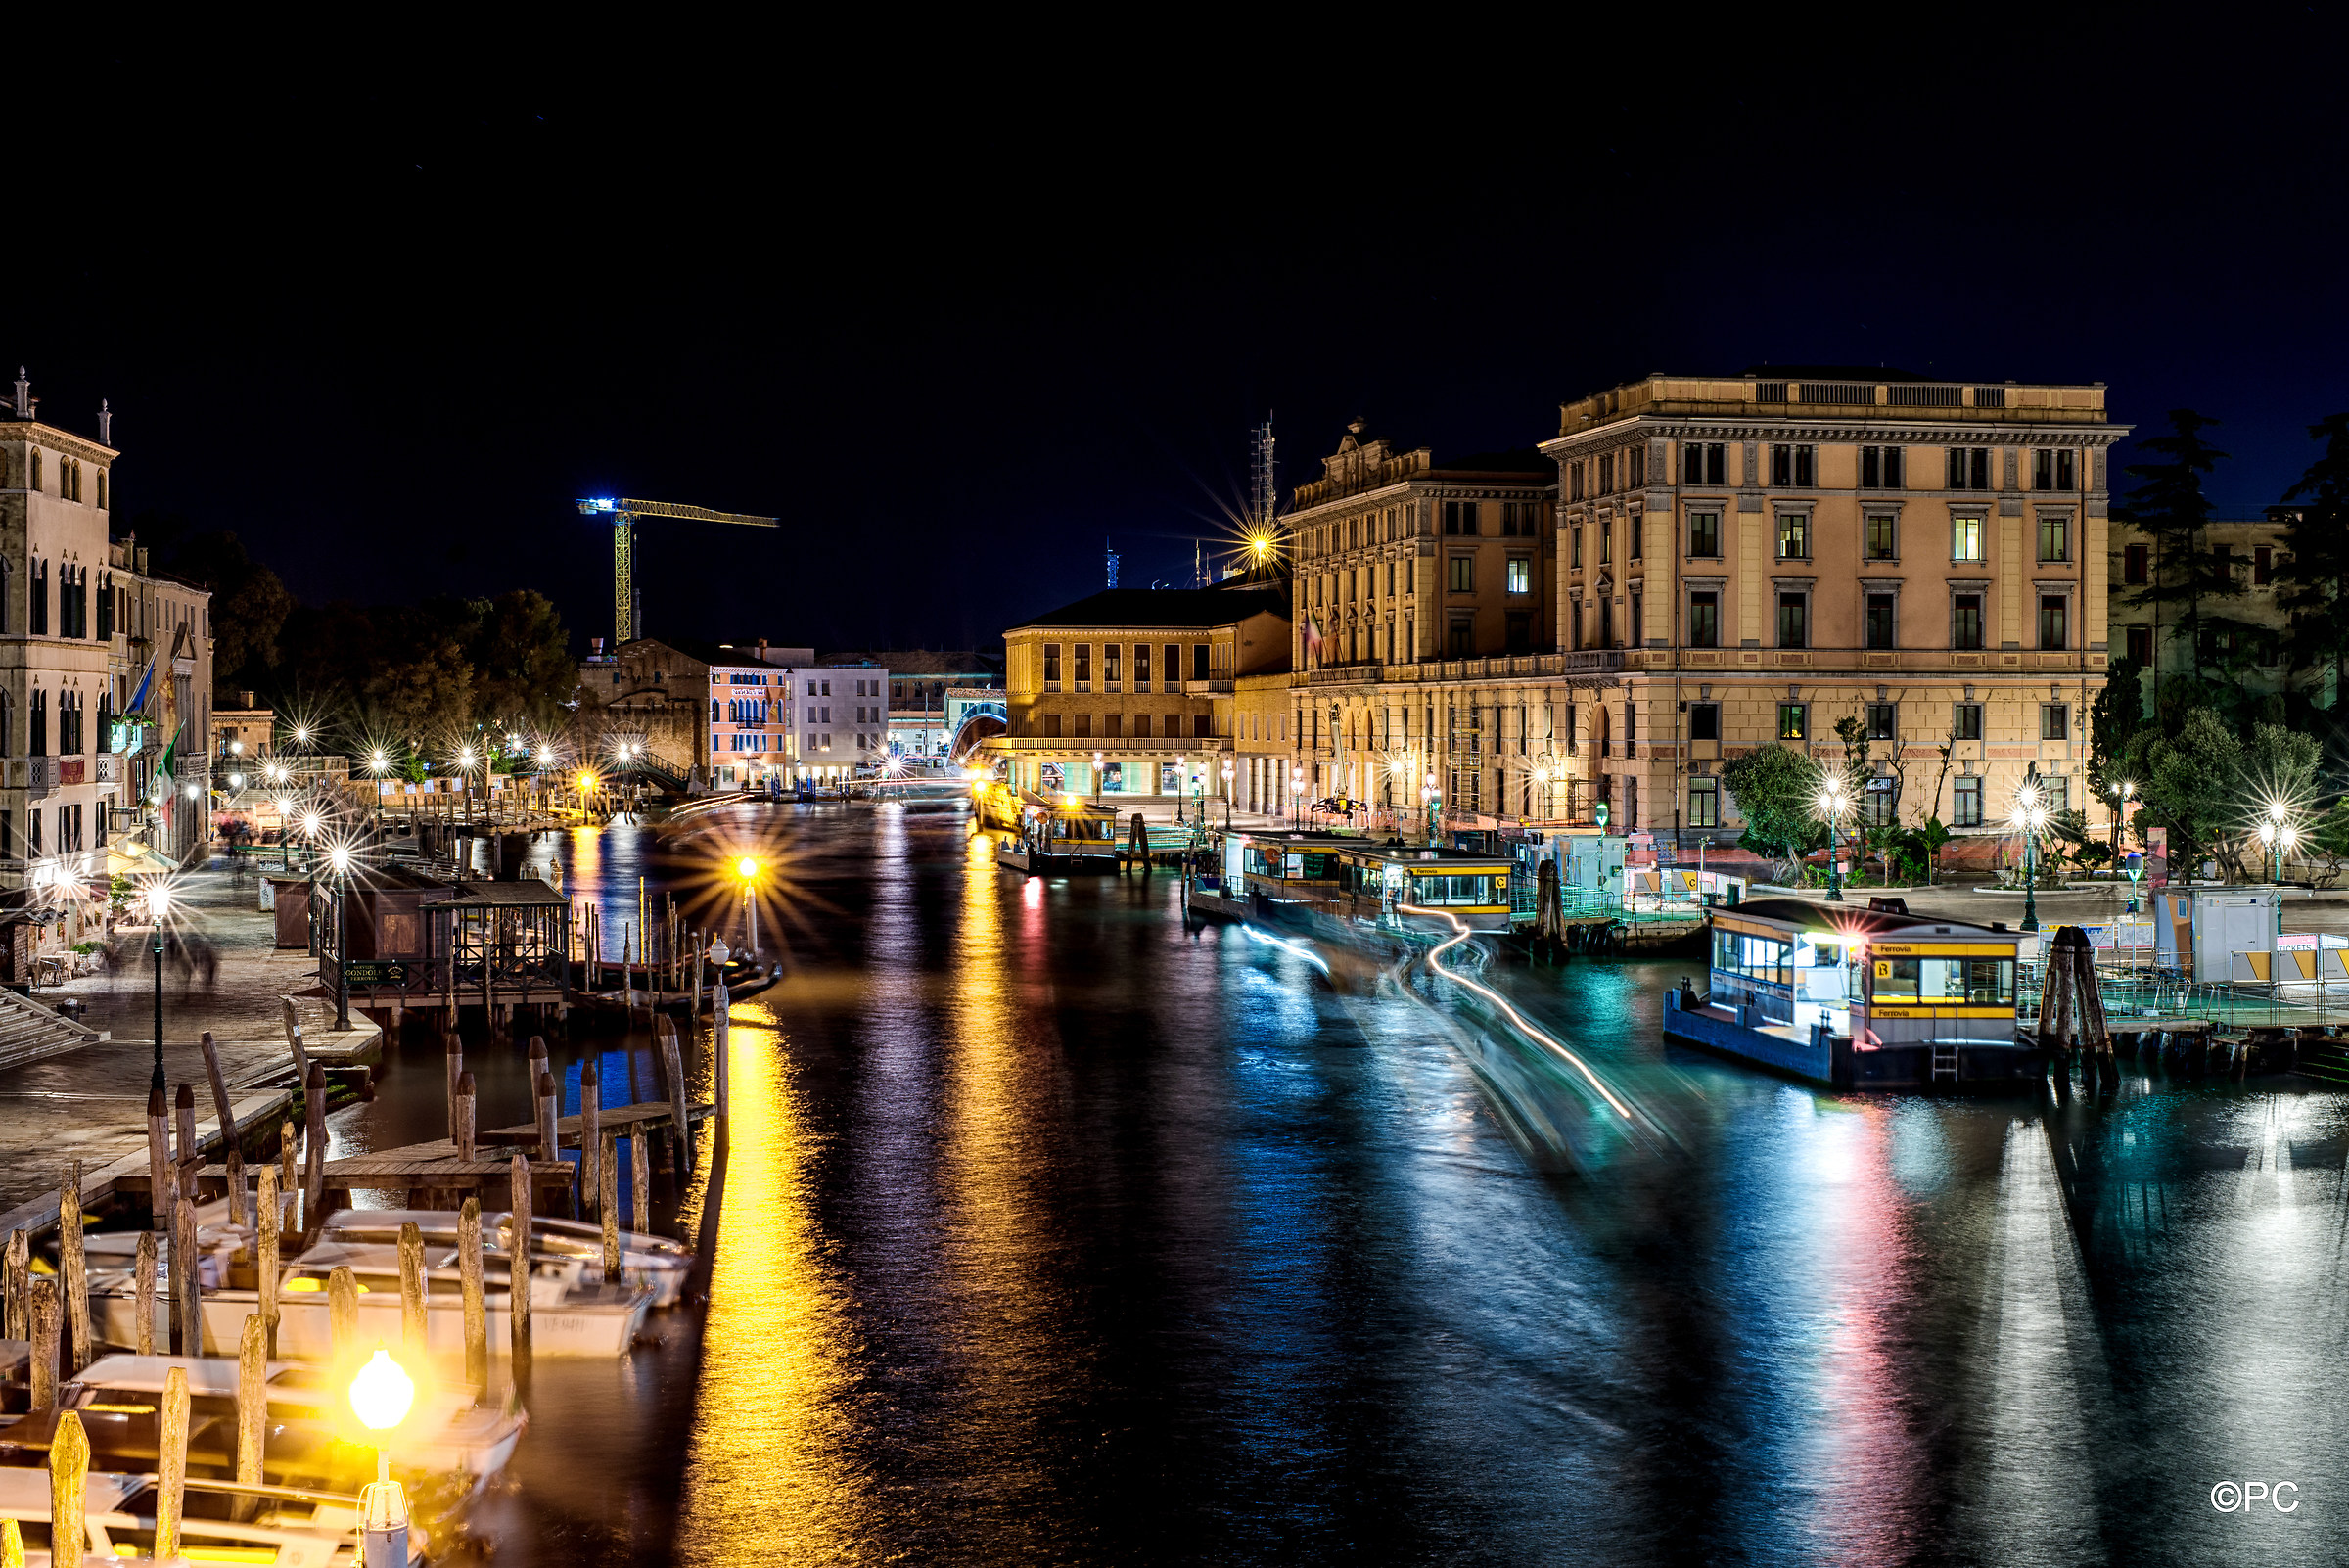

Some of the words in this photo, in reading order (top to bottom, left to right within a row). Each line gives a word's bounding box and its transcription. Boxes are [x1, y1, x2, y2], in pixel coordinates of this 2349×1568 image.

[1497, 878, 1504, 887] C
[1688, 878, 1696, 887] C
[1880, 945, 1911, 953] Ferrovia
[1878, 963, 1888, 976] B
